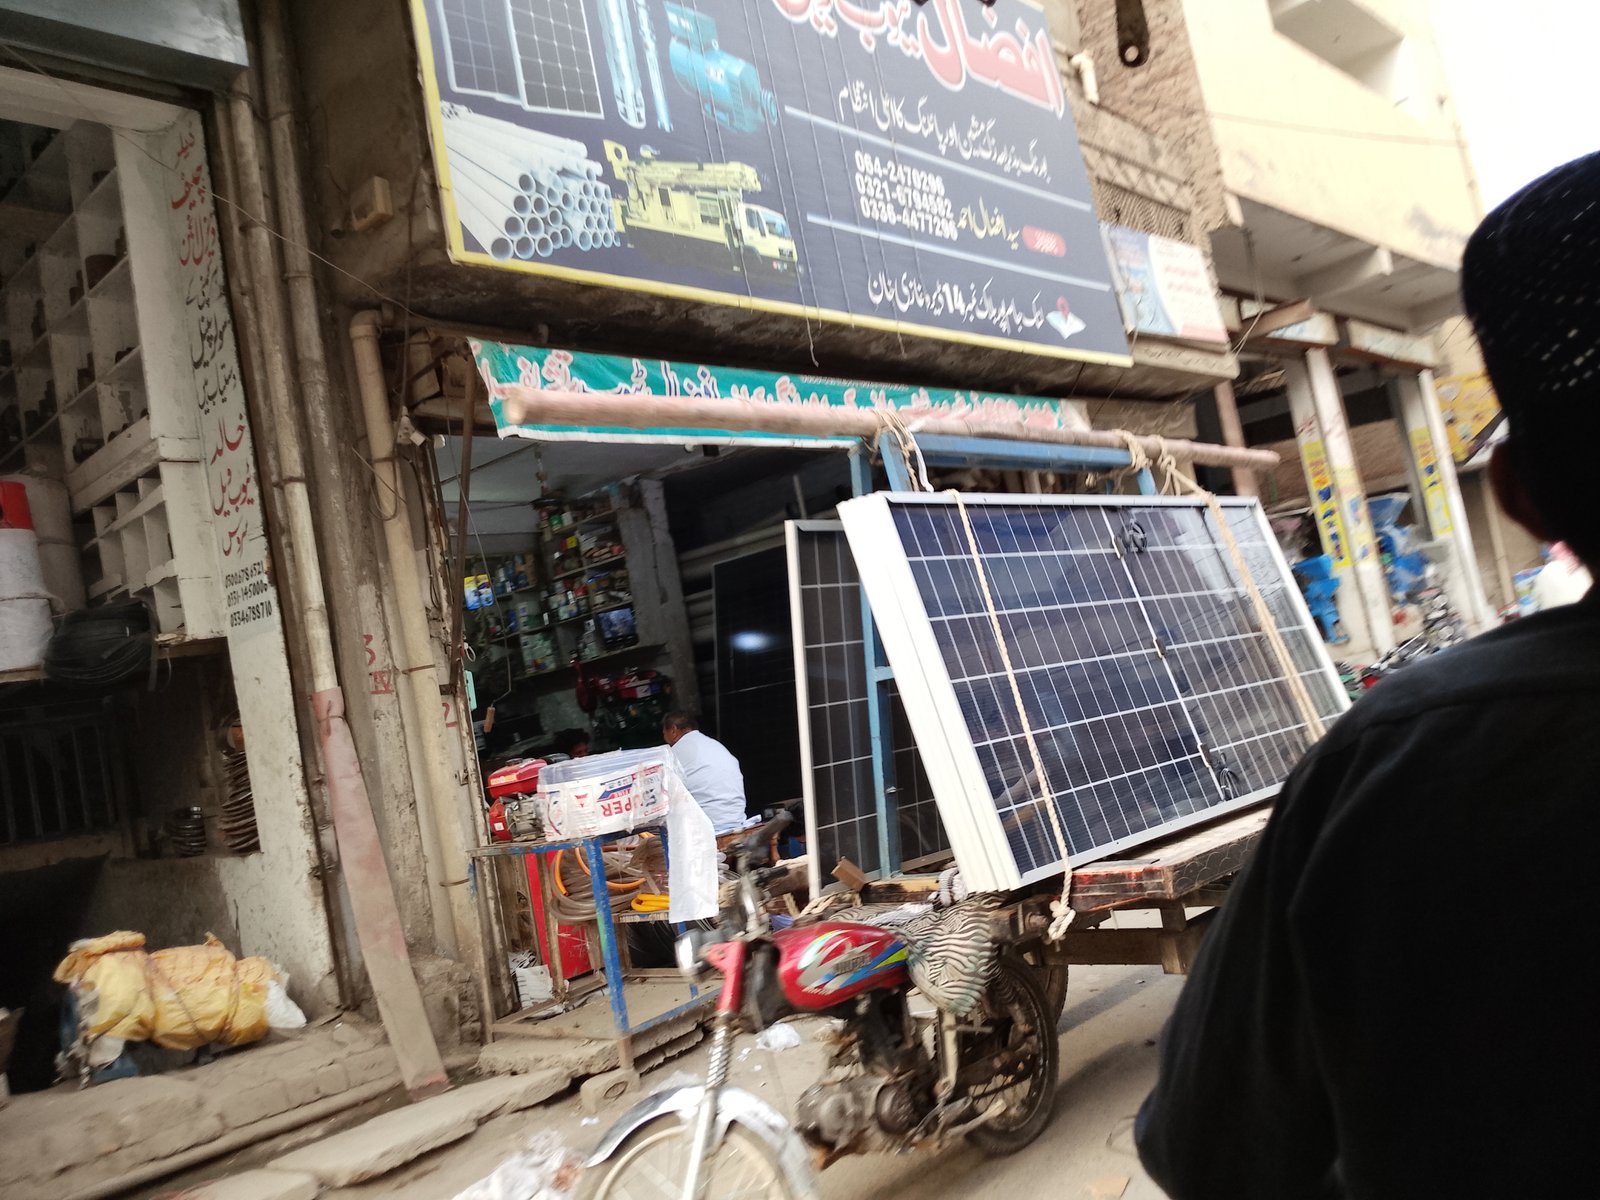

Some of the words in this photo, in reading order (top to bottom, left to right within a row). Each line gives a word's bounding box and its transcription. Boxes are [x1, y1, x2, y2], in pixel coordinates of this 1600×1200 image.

[867, 271, 895, 305] خان
[943, 282, 967, 316] 14
[210, 412, 246, 466] خالد
[213, 467, 232, 517] ویل
[228, 461, 256, 512] ٹیوب
